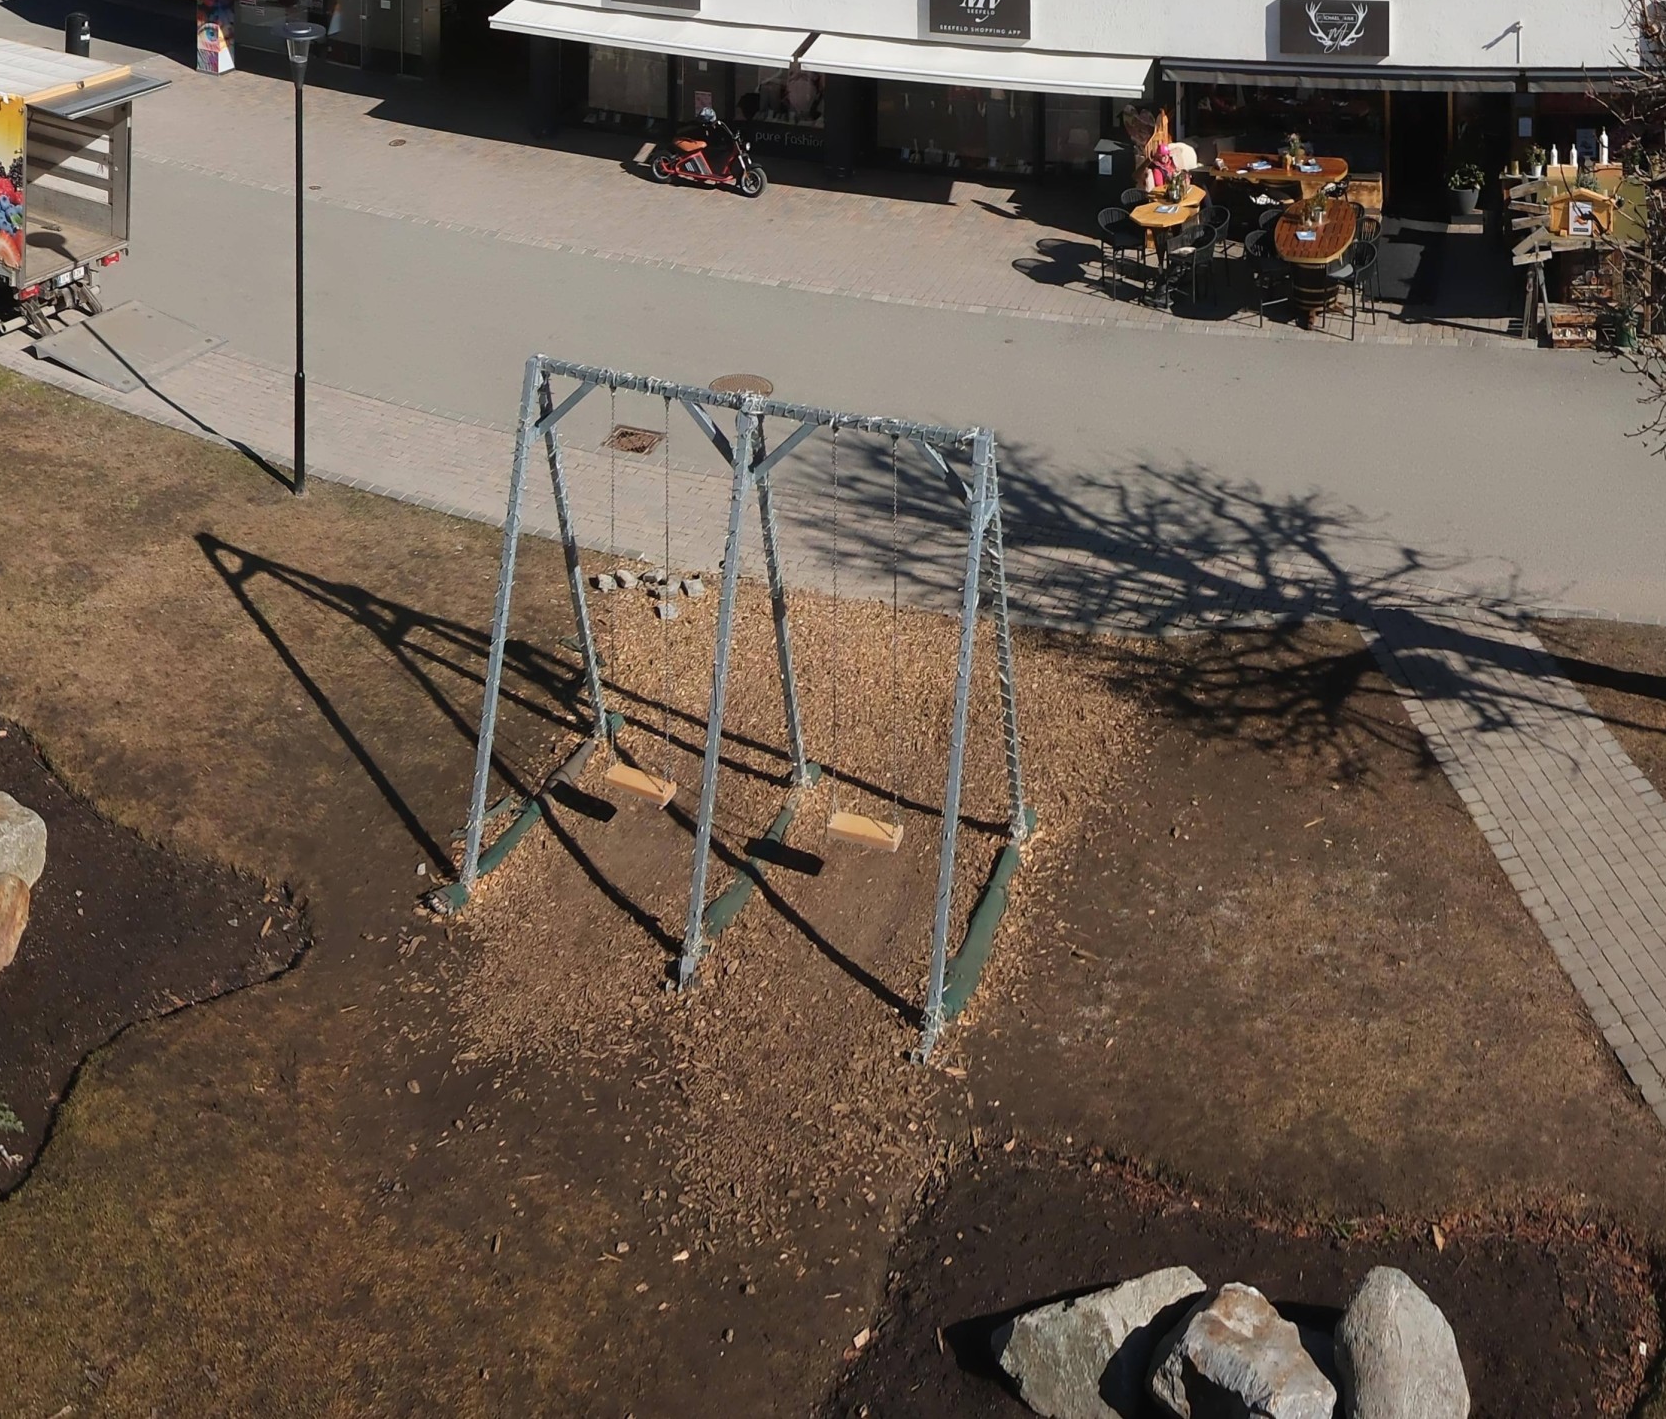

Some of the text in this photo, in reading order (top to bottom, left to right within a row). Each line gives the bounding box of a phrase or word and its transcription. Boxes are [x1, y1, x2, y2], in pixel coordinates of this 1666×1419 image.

[966, 8, 996, 16] SEEFELD
[939, 24, 969, 32] SEEFELD
[970, 26, 1006, 35] SHOPPING
[755, 132, 781, 143] pure
